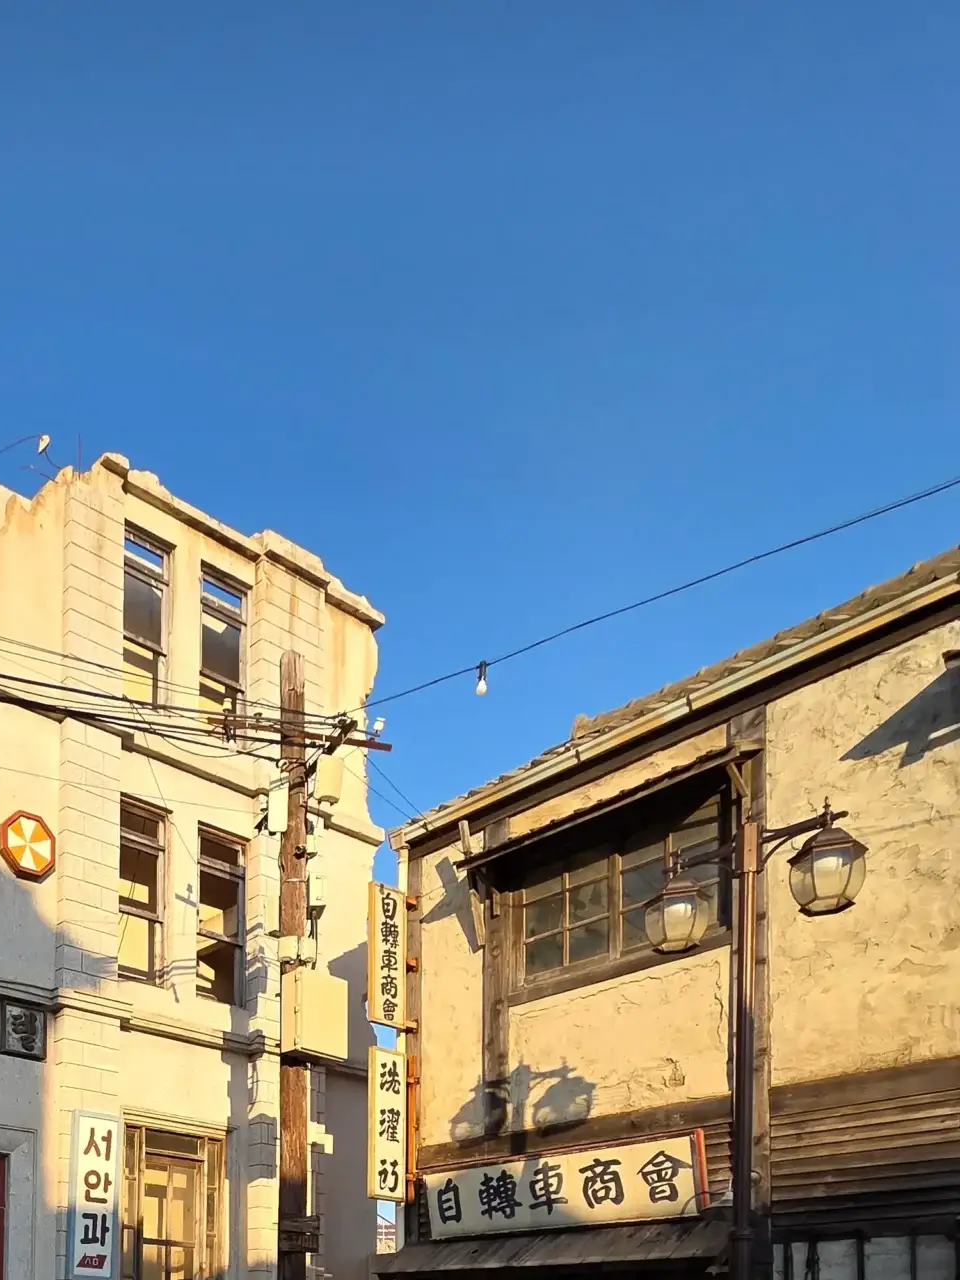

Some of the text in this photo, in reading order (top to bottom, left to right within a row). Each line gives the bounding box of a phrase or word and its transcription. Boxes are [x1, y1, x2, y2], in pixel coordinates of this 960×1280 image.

[80, 1127, 112, 1247] 서안과
[436, 1150, 693, 1225] 自轉車商會
